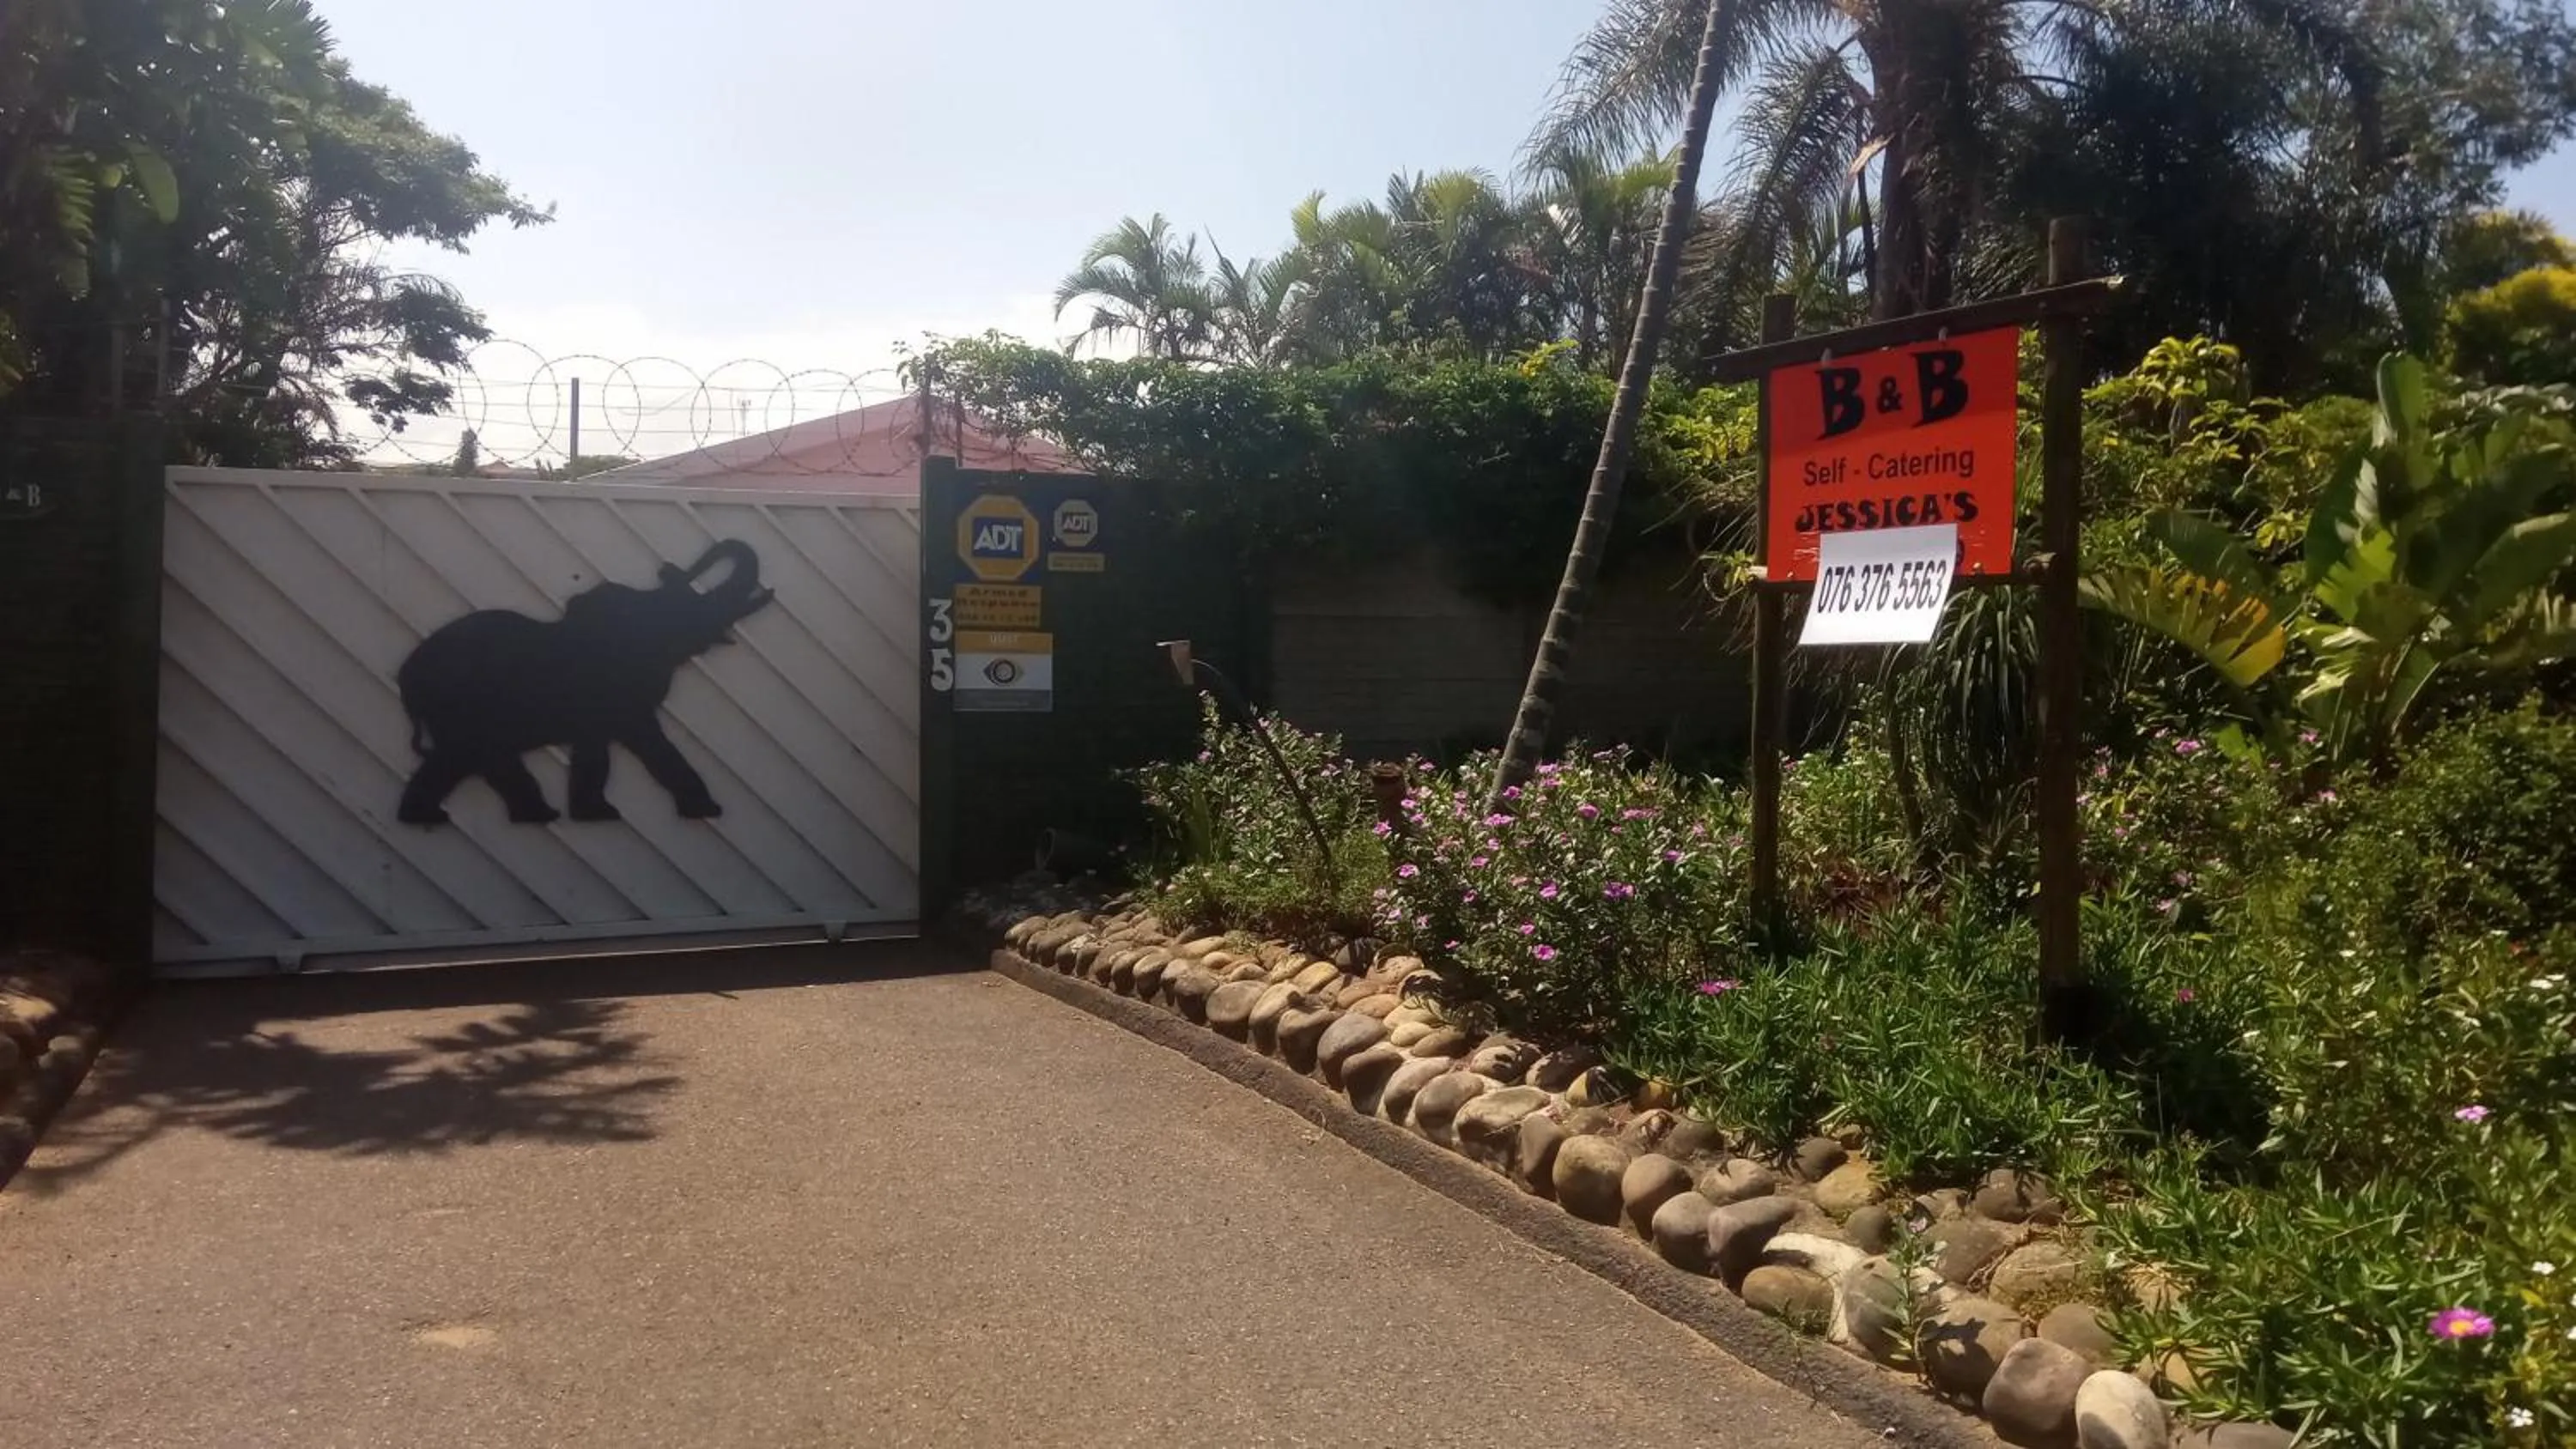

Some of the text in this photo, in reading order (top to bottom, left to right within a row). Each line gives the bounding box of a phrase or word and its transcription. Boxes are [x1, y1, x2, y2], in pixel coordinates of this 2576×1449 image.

[1815, 350, 1969, 441] B & B
[1804, 456, 1847, 487] Self
[1868, 446, 1975, 480] Catering
[1063, 516, 1089, 531] ADT
[1795, 492, 1979, 533] JESSICA'S
[974, 524, 1024, 552] ADT
[1818, 560, 1947, 615] 076 376 5563
